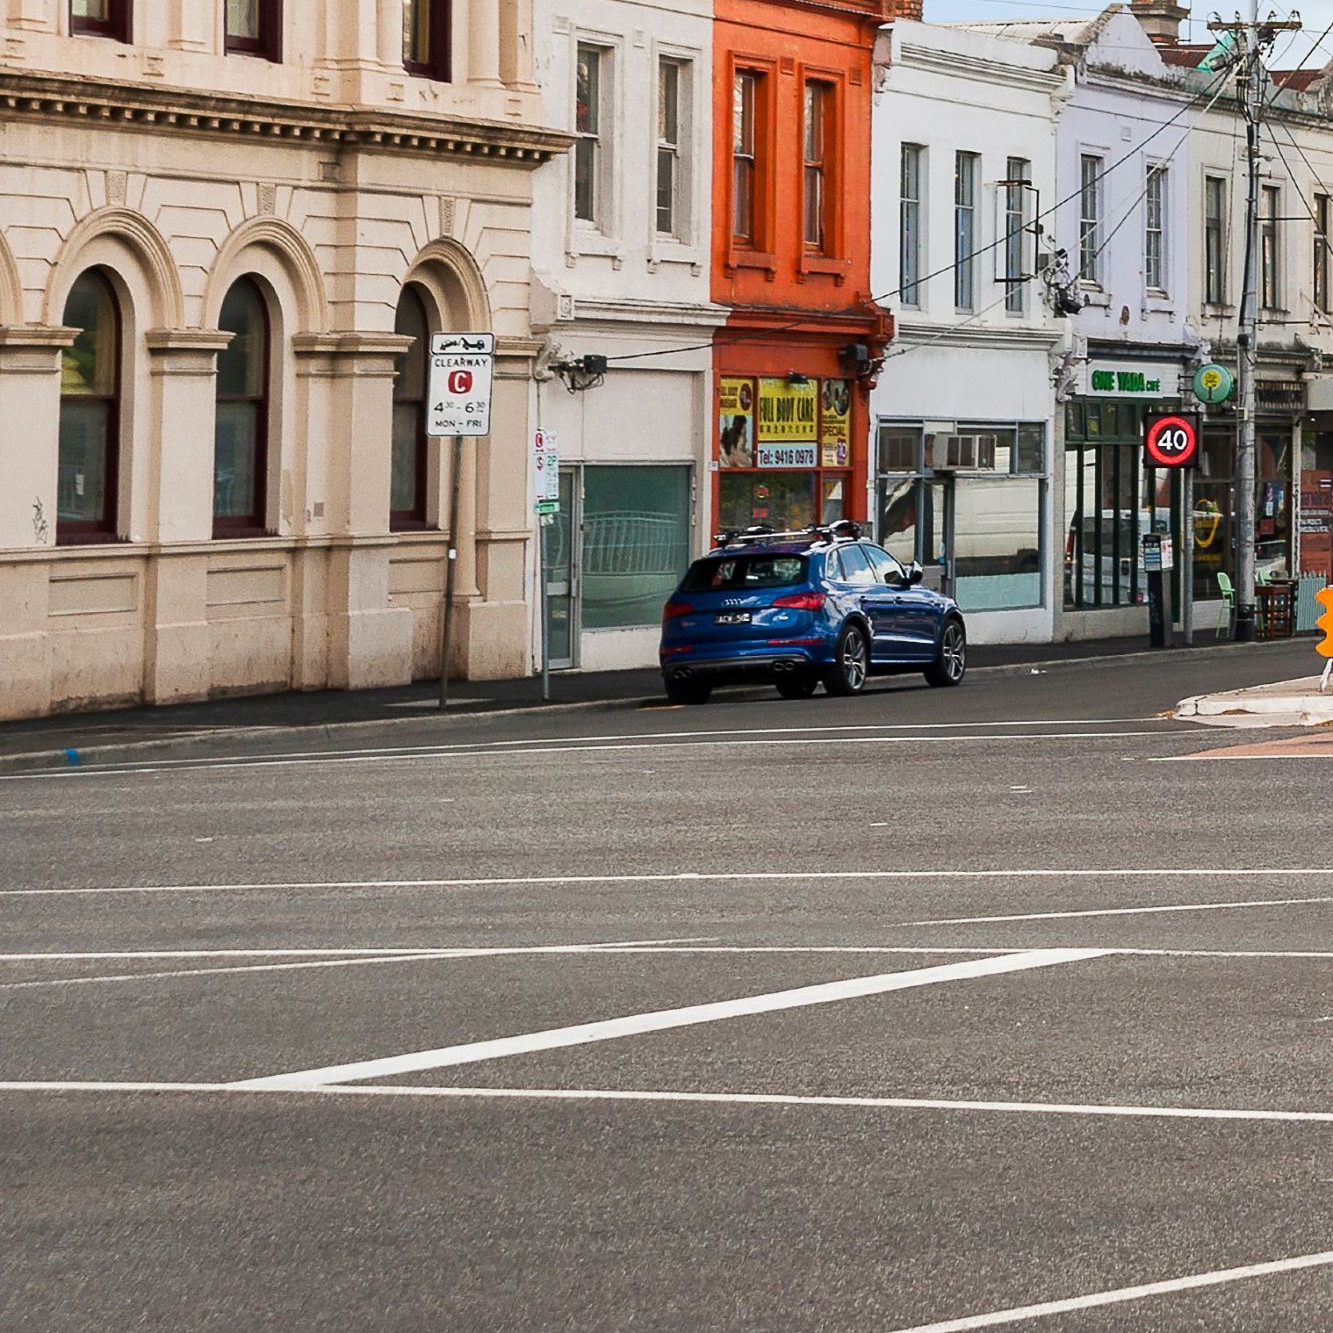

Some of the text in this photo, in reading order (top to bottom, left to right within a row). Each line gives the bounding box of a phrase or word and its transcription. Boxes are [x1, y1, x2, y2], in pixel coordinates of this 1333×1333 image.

[434, 358, 488, 368] CLEARWAY
[454, 372, 467, 392] C
[1091, 369, 1115, 392] ONE
[776, 397, 794, 422] BODY
[797, 397, 814, 422] CARE
[434, 419, 456, 427] MON
[466, 419, 482, 427] FRI
[1157, 429, 1188, 452] 40
[759, 449, 773, 464] Tel:
[775, 449, 794, 465] 9416
[795, 449, 814, 465] 0978
